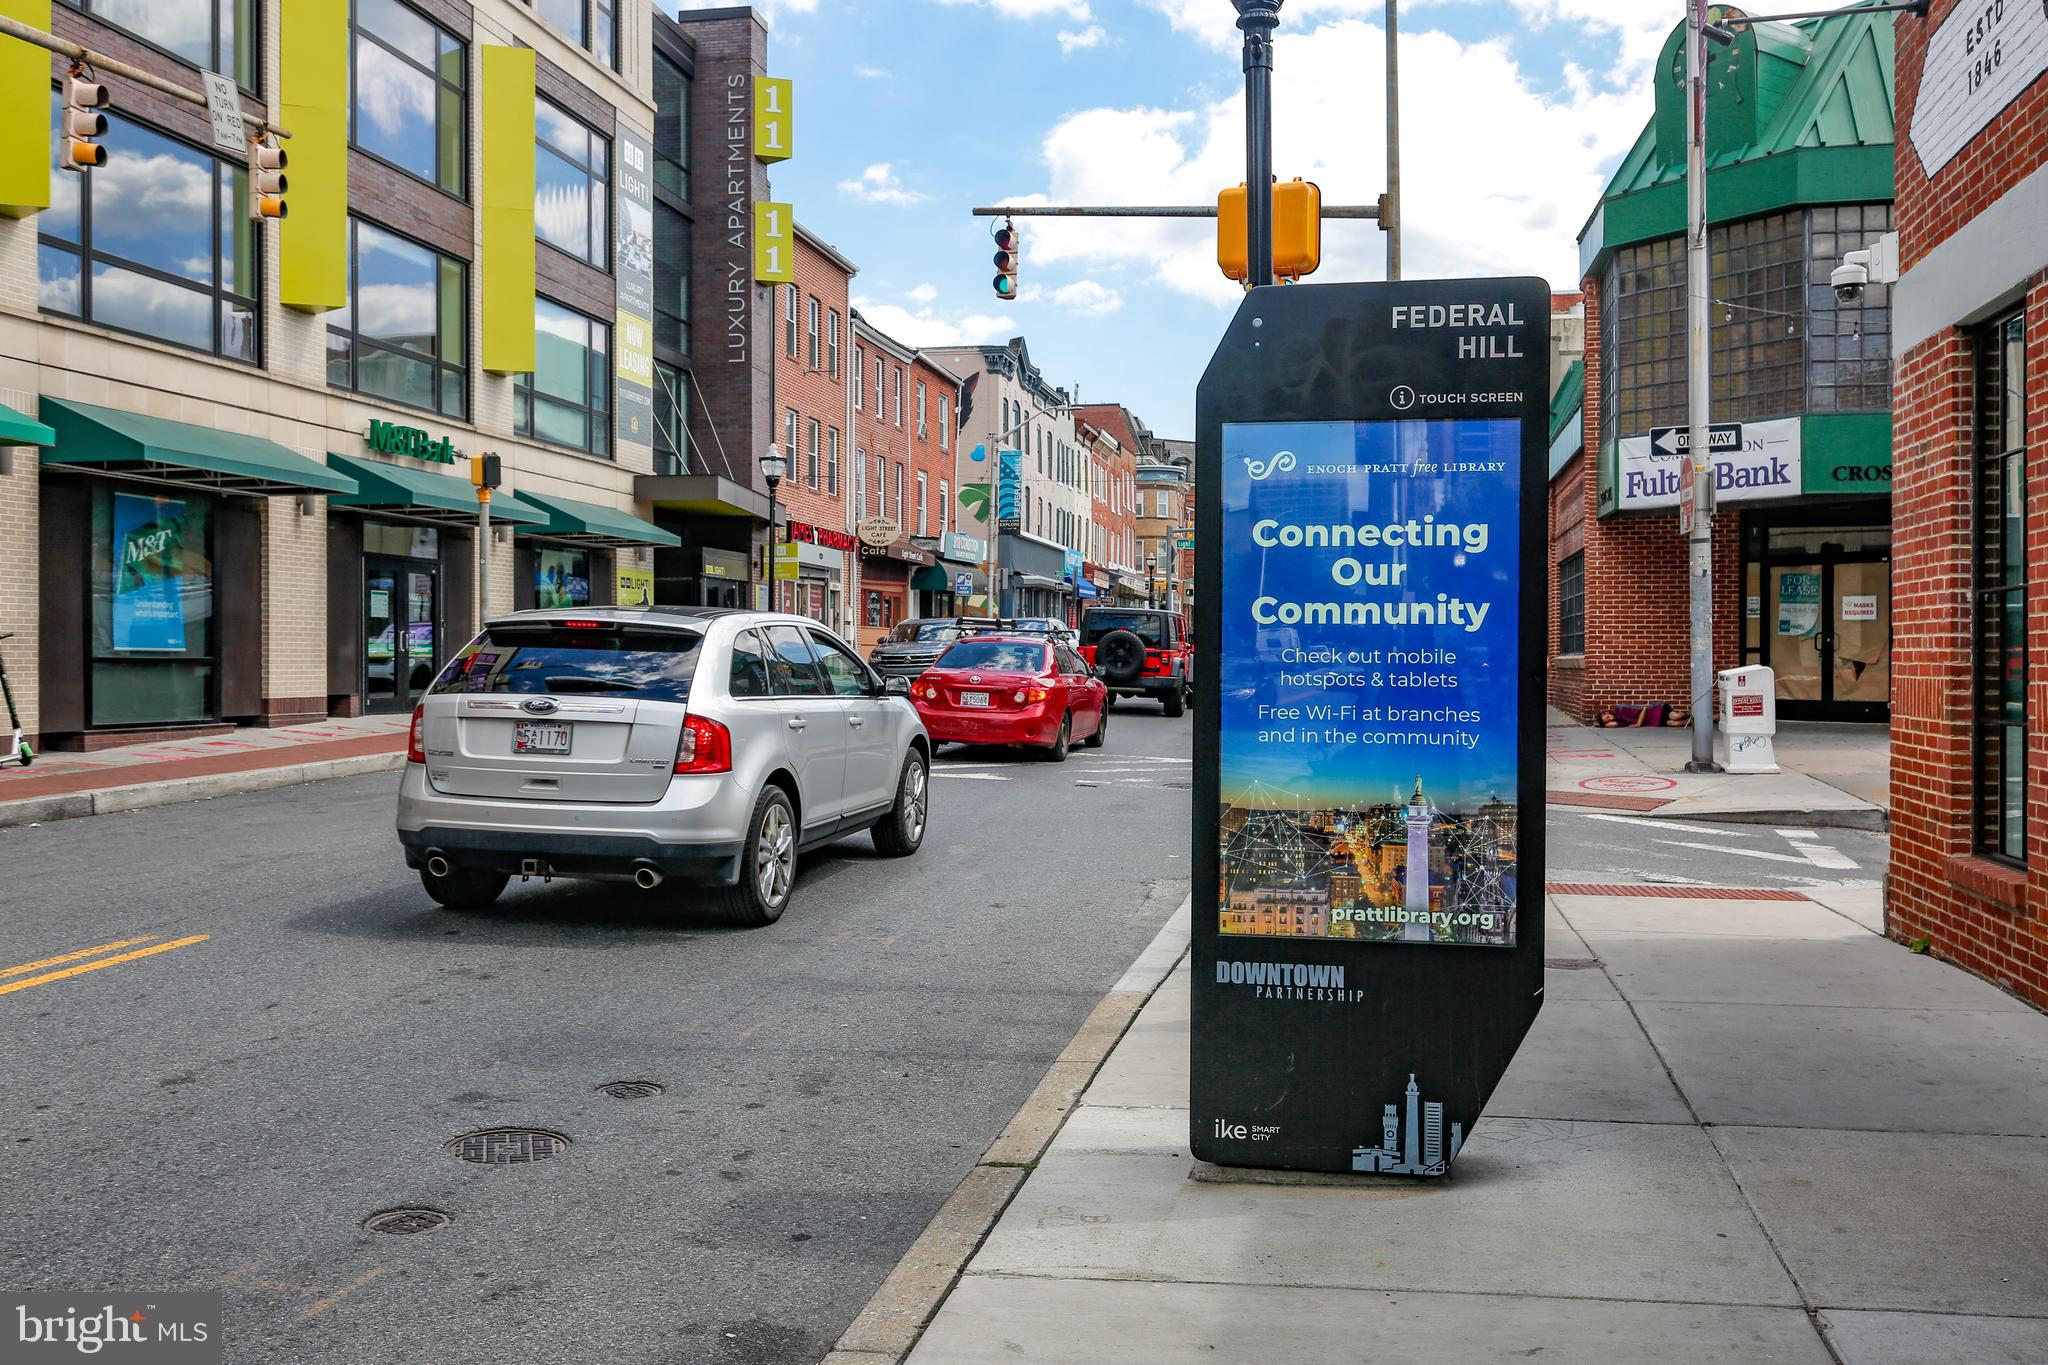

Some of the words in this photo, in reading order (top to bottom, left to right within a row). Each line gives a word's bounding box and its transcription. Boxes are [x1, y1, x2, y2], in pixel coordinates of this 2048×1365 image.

[1968, 39, 2001, 95] 1846
[214, 81, 227, 95] NO
[214, 95, 234, 111] TURN
[212, 110, 223, 123] ON
[226, 114, 241, 129] RED
[728, 74, 745, 248] APARTMENTS
[620, 169, 646, 201] LIGHT
[619, 294, 650, 313] APARTMENTS
[728, 262, 745, 364] LUXURY
[1391, 303, 1524, 329] FEDERAL
[626, 322, 644, 348] NOW
[1458, 335, 1524, 359] HILL
[619, 348, 650, 377] LEASING
[1418, 393, 1466, 404] TOUCH
[1470, 392, 1523, 403] SCREEN
[368, 418, 417, 457] M&T
[414, 428, 456, 465] Bank
[1306, 464, 1357, 474] ENOCH
[1364, 463, 1408, 473] PRATT
[1410, 458, 1438, 478] free
[1443, 462, 1506, 472] LIBRARY
[1714, 457, 1792, 490] Bank
[1252, 514, 1489, 553] Connecting
[126, 529, 172, 564] M&T
[1331, 557, 1407, 586] Our
[1786, 575, 1811, 585] FOR
[631, 577, 648, 590] LIGHT
[1780, 585, 1818, 596] LEASE
[1251, 592, 1491, 632] Community
[1281, 648, 1343, 664] Check
[1347, 650, 1381, 665] out
[1387, 648, 1457, 665] mobile
[1280, 670, 1366, 690] hotspots
[1370, 672, 1384, 687] &
[1389, 671, 1458, 688] tablets
[1258, 704, 1300, 720] Free
[1306, 704, 1356, 721] Wi-Fi
[1362, 706, 1382, 721] at
[1388, 705, 1481, 722] branches
[1258, 727, 1295, 744] and
[1301, 728, 1318, 743] in
[1324, 728, 1357, 744] the
[1362, 729, 1480, 750] community
[1331, 906, 1495, 930] prattlibrary.org
[1216, 960, 1345, 988] DOWNTOWN
[1256, 986, 1364, 1002] PARTNERSHIP
[1214, 1118, 1248, 1140] ike
[1251, 1125, 1281, 1134] SMART
[1251, 1133, 1271, 1141] CITY
